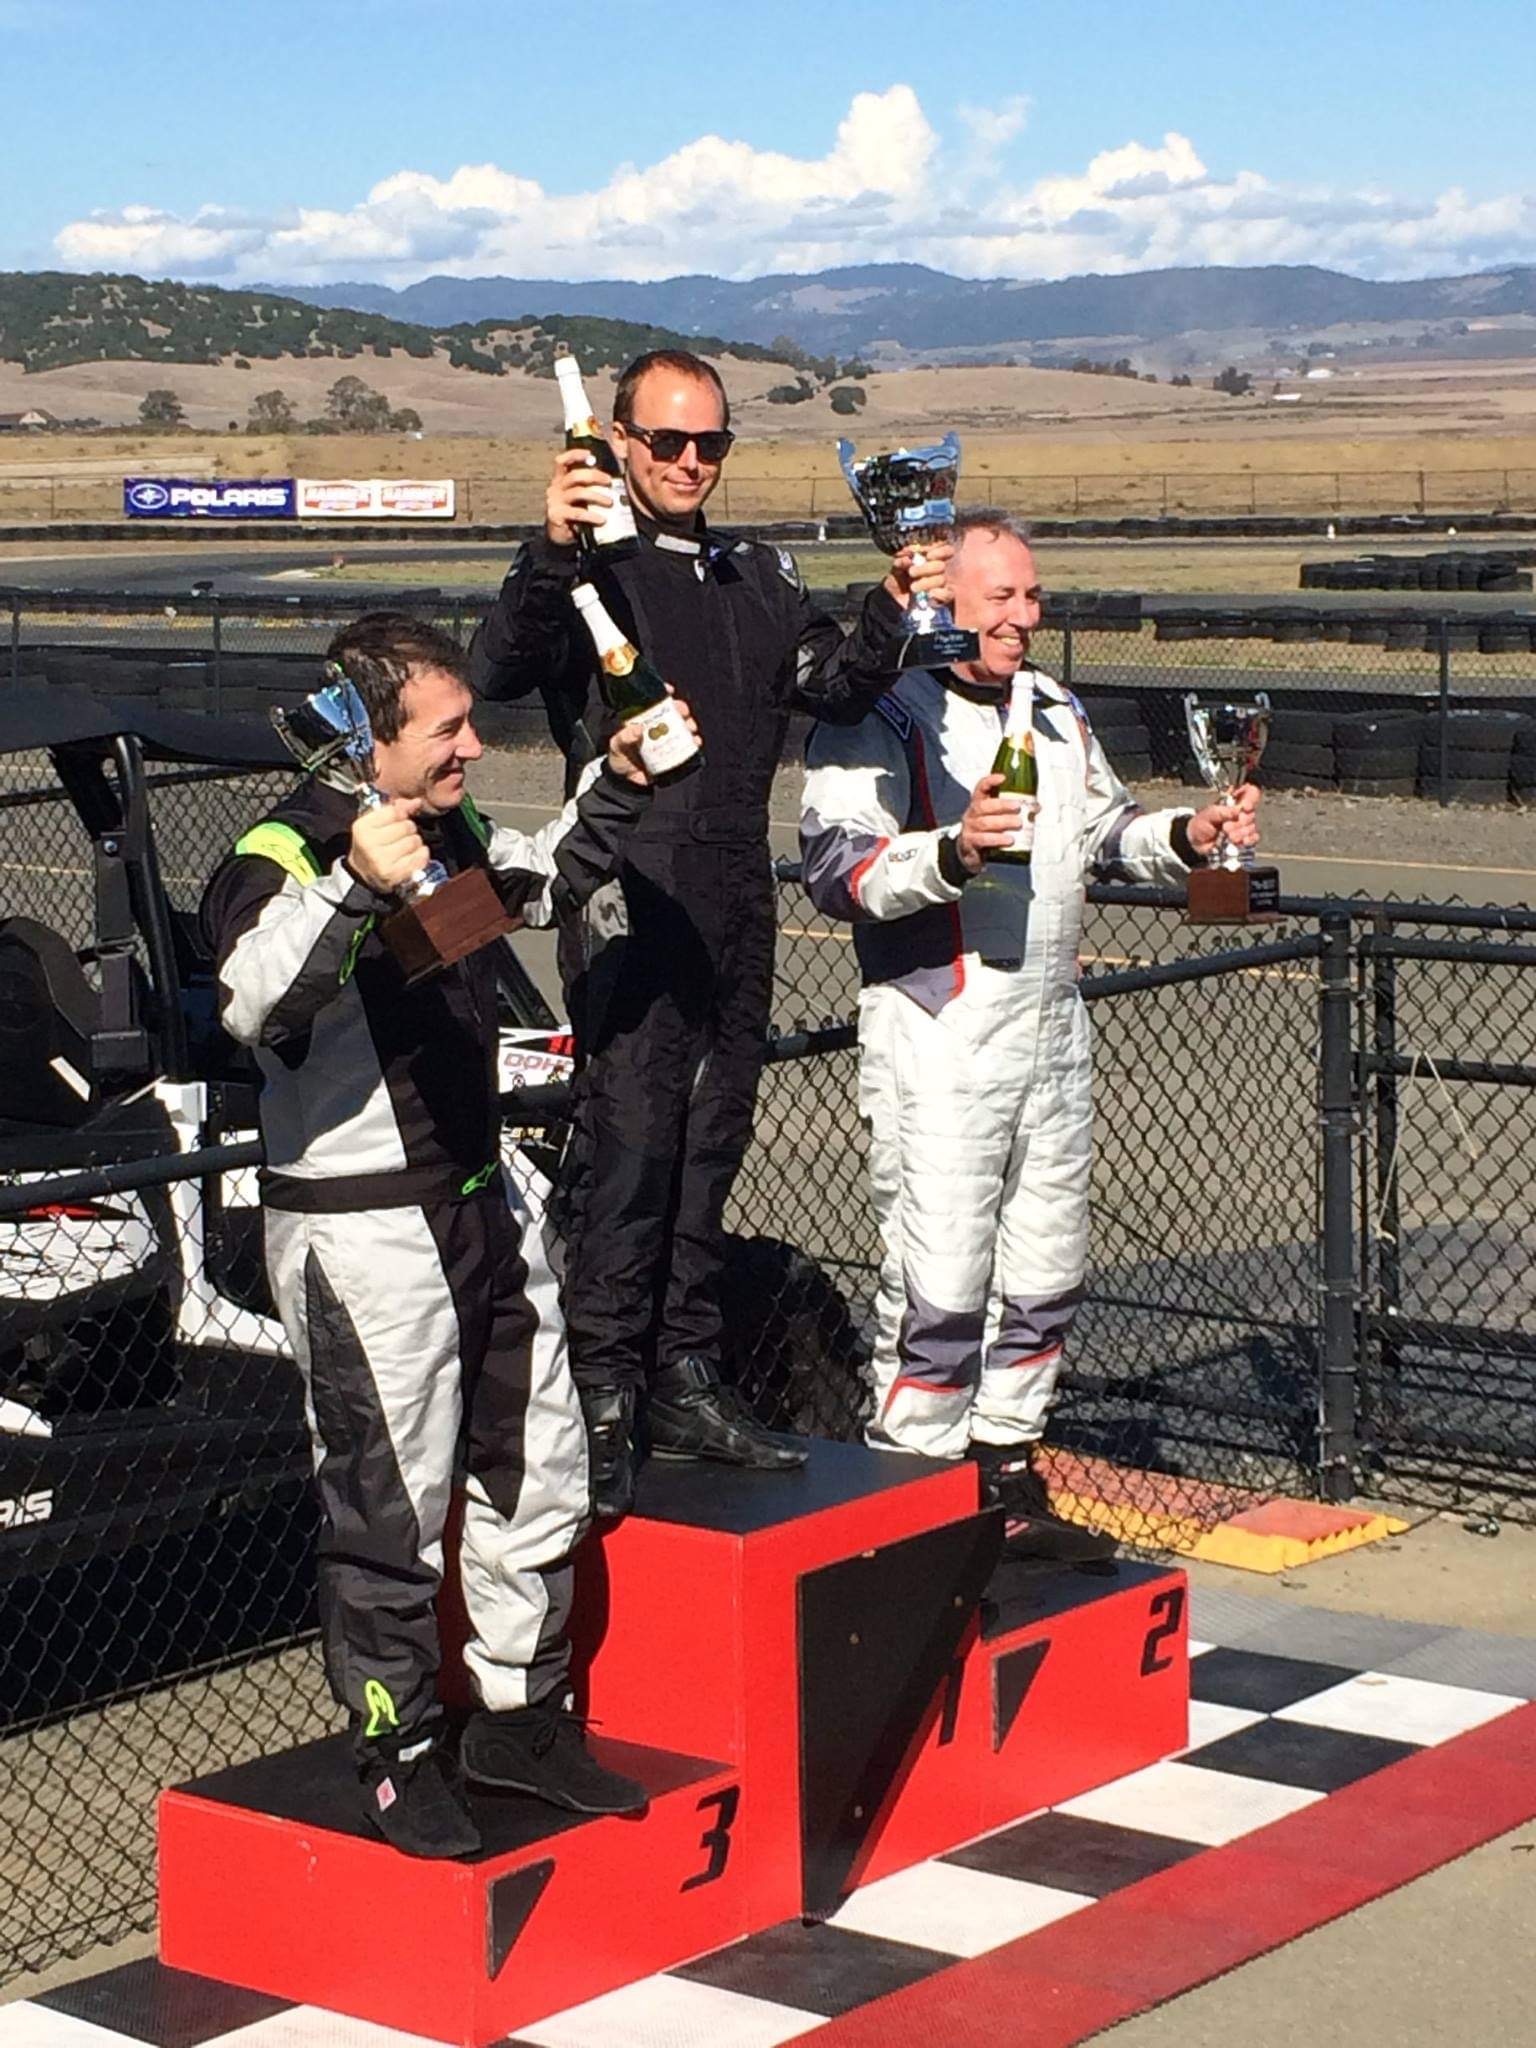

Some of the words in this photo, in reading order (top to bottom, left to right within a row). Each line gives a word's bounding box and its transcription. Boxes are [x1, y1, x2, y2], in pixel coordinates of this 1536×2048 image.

[170, 488, 287, 506] POLARIS
[1141, 1586, 1186, 1677] 2
[681, 1786, 740, 1892] 3
